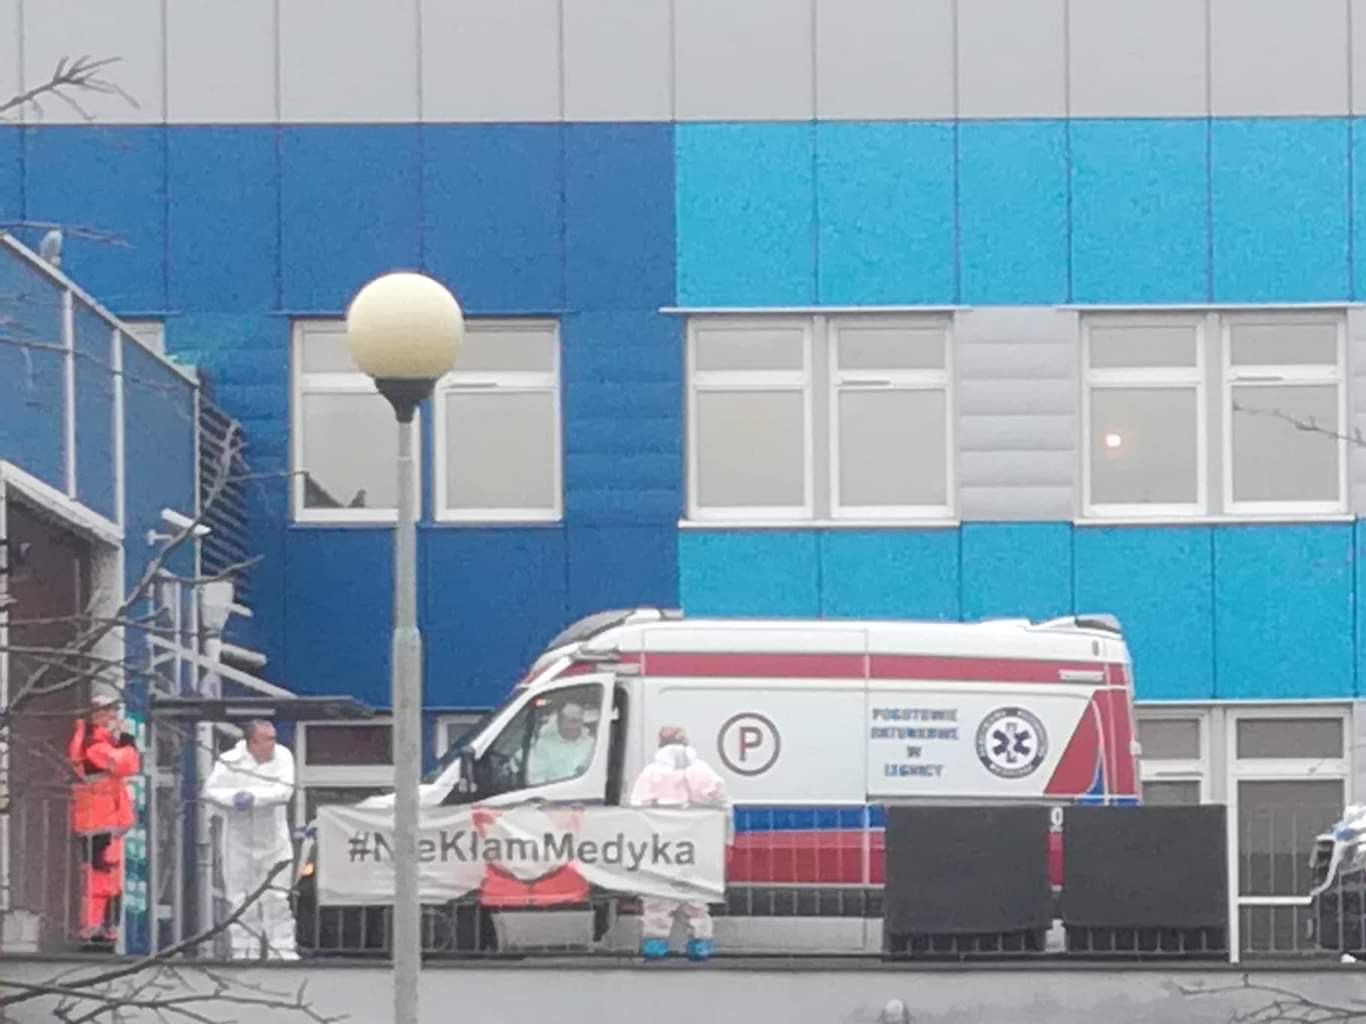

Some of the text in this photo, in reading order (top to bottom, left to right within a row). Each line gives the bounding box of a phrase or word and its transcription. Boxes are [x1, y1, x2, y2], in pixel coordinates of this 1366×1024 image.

[740, 726, 764, 762] P
[906, 746, 922, 758] W
[348, 830, 696, 871] #NeKłamMedyka
